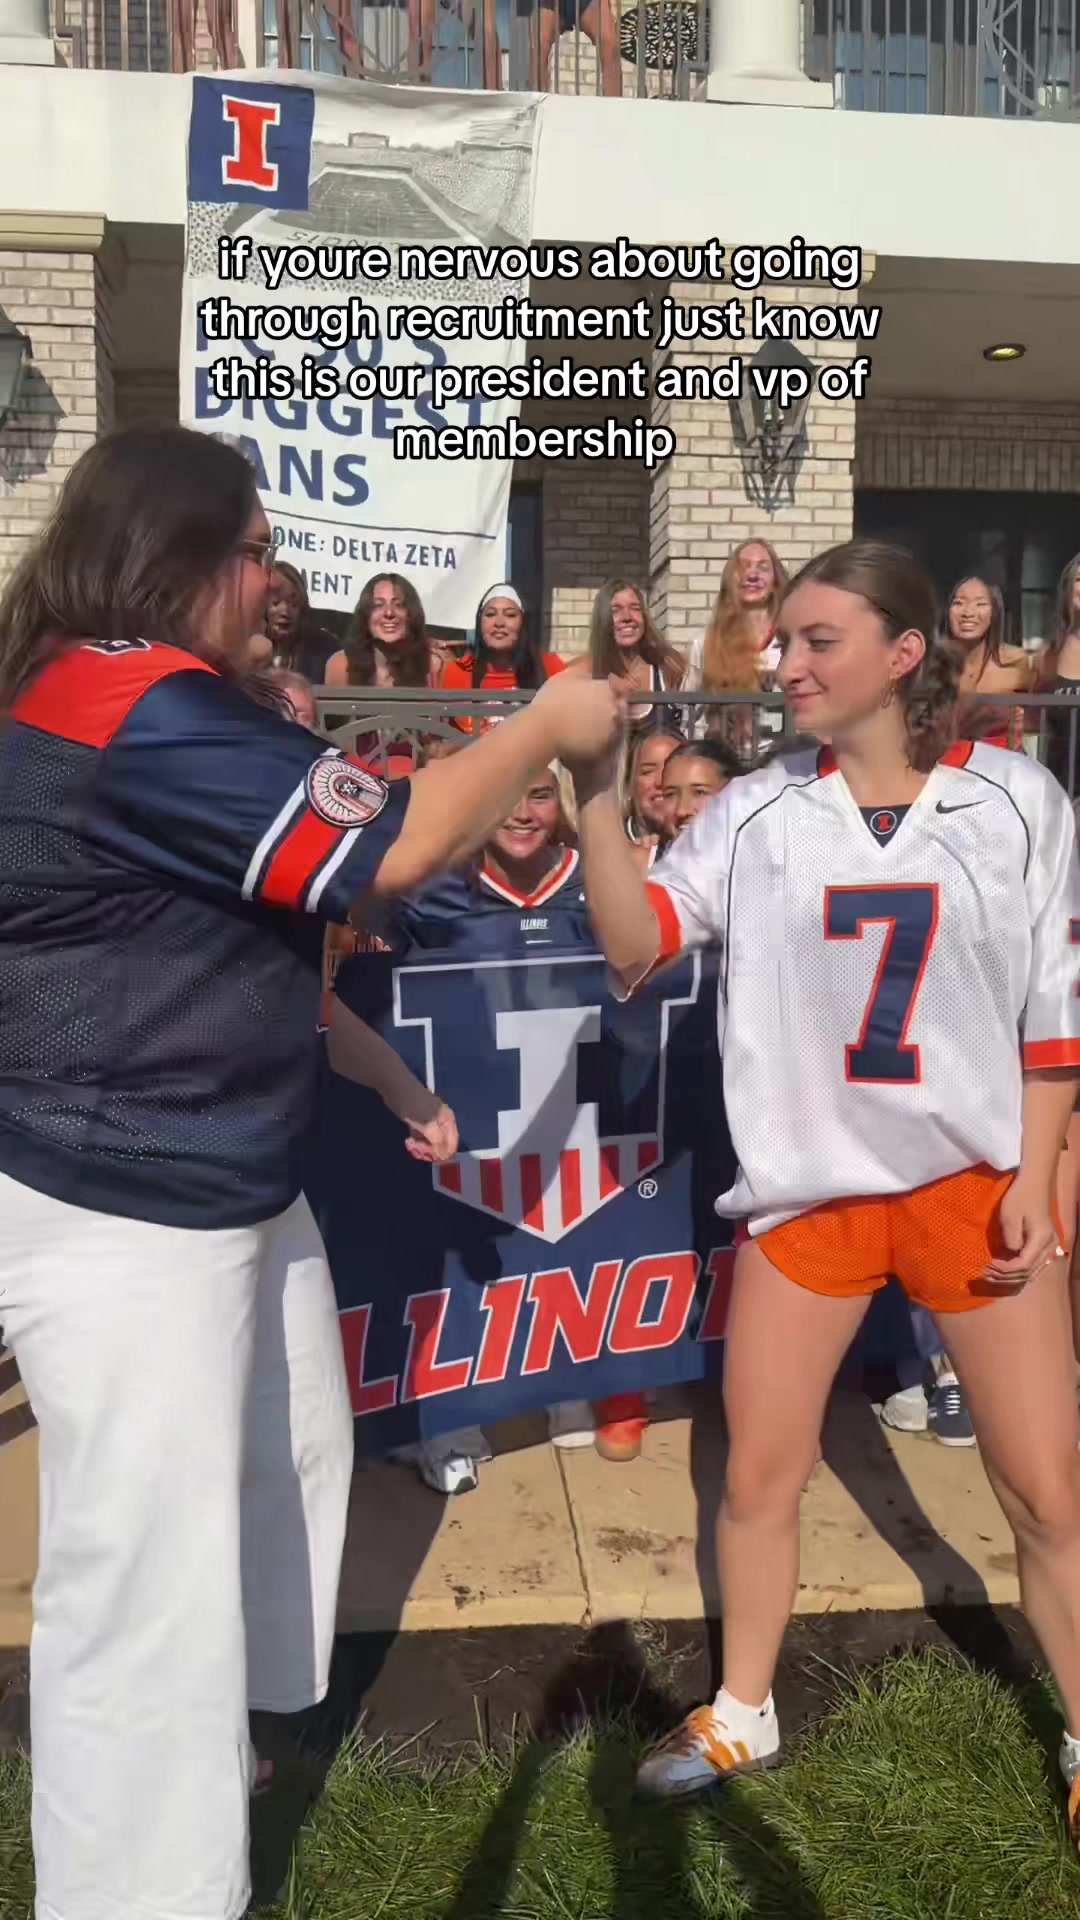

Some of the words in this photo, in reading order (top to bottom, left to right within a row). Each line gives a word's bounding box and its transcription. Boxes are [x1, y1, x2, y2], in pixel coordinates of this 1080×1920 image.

[222, 94, 281, 192] I
[240, 434, 371, 507] ANS
[301, 567, 353, 596] ENT
[333, 535, 398, 563] DELTA
[404, 543, 457, 570] ZETA
[824, 882, 940, 1085] 7
[337, 1248, 737, 1418] LLINOI
